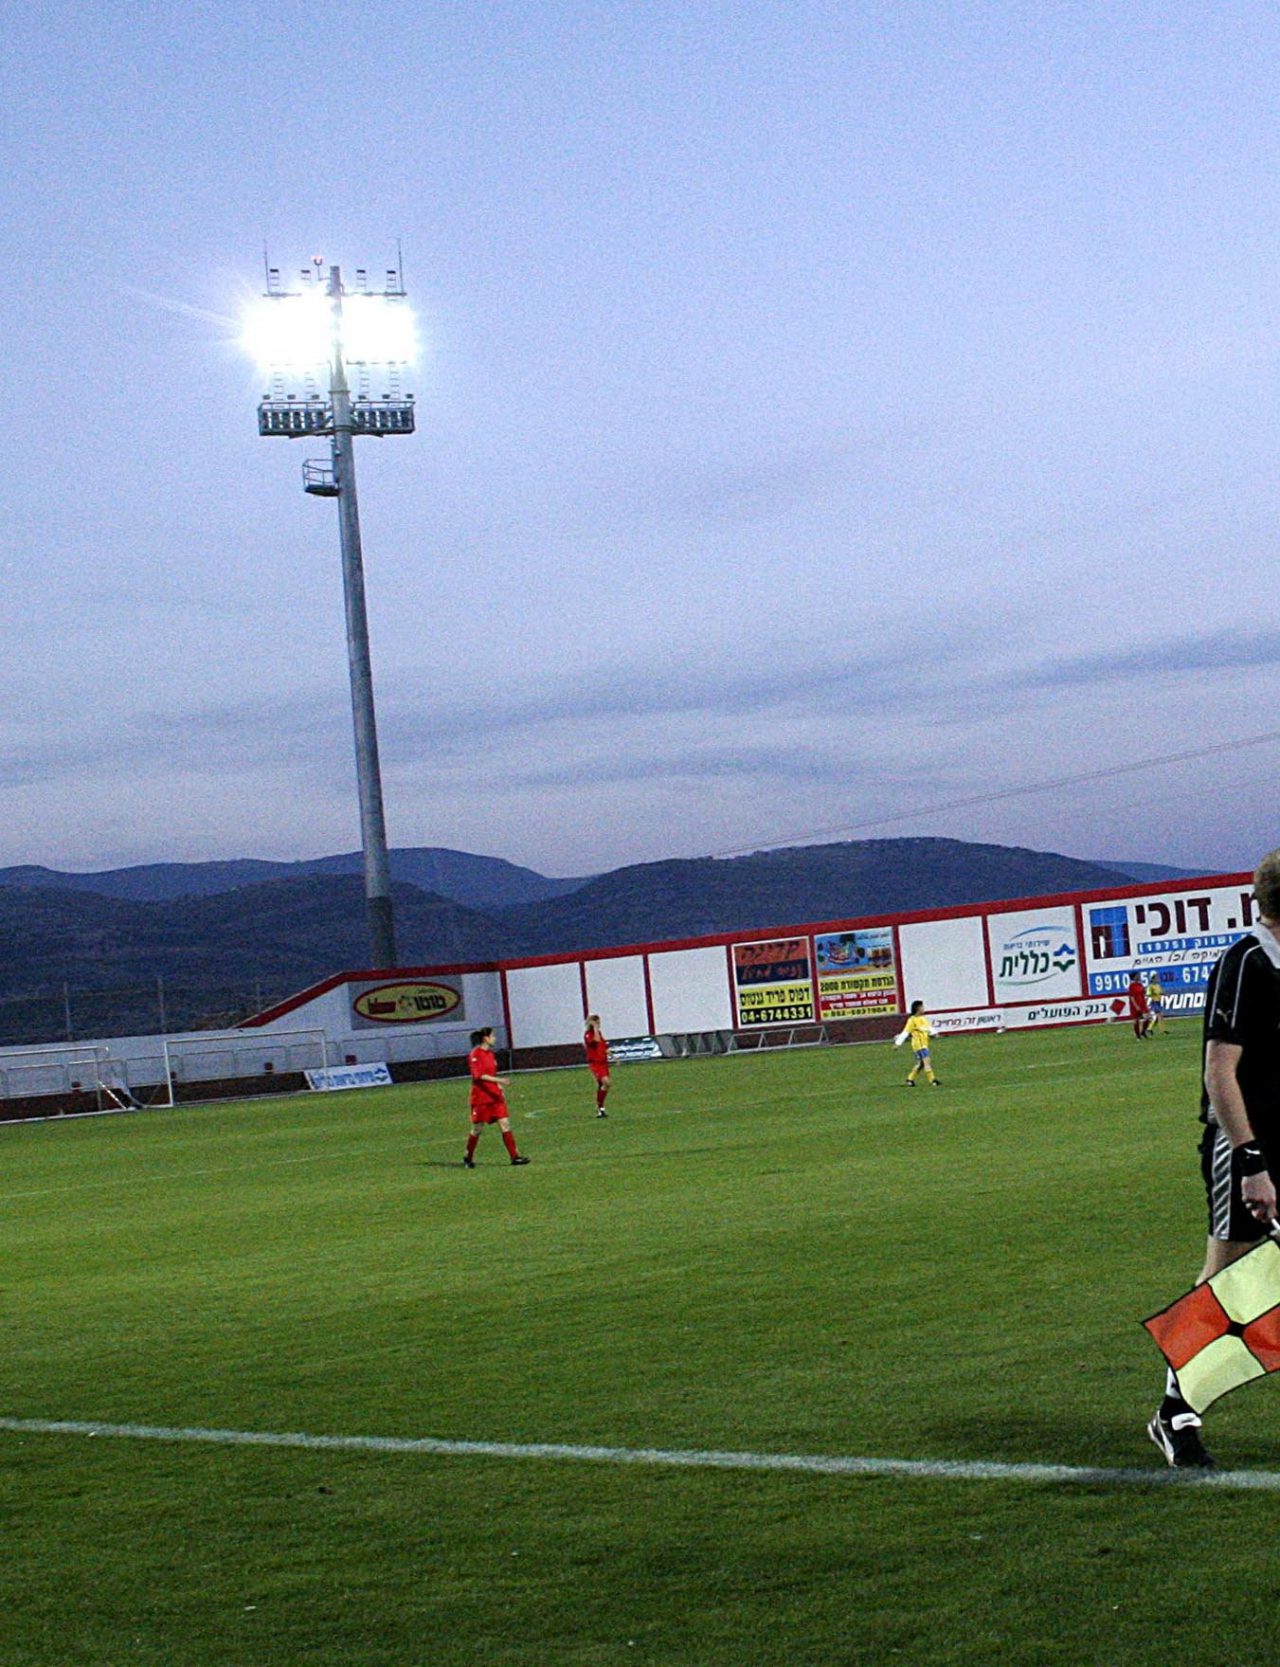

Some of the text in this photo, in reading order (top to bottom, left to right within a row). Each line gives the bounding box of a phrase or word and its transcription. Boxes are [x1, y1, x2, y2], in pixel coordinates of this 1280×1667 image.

[1135, 897, 1212, 937] דוכי
[999, 950, 1050, 977] כללית
[741, 1006, 812, 1023] 04-6744331
[1028, 1003, 1108, 1021] בנק הפועלים
